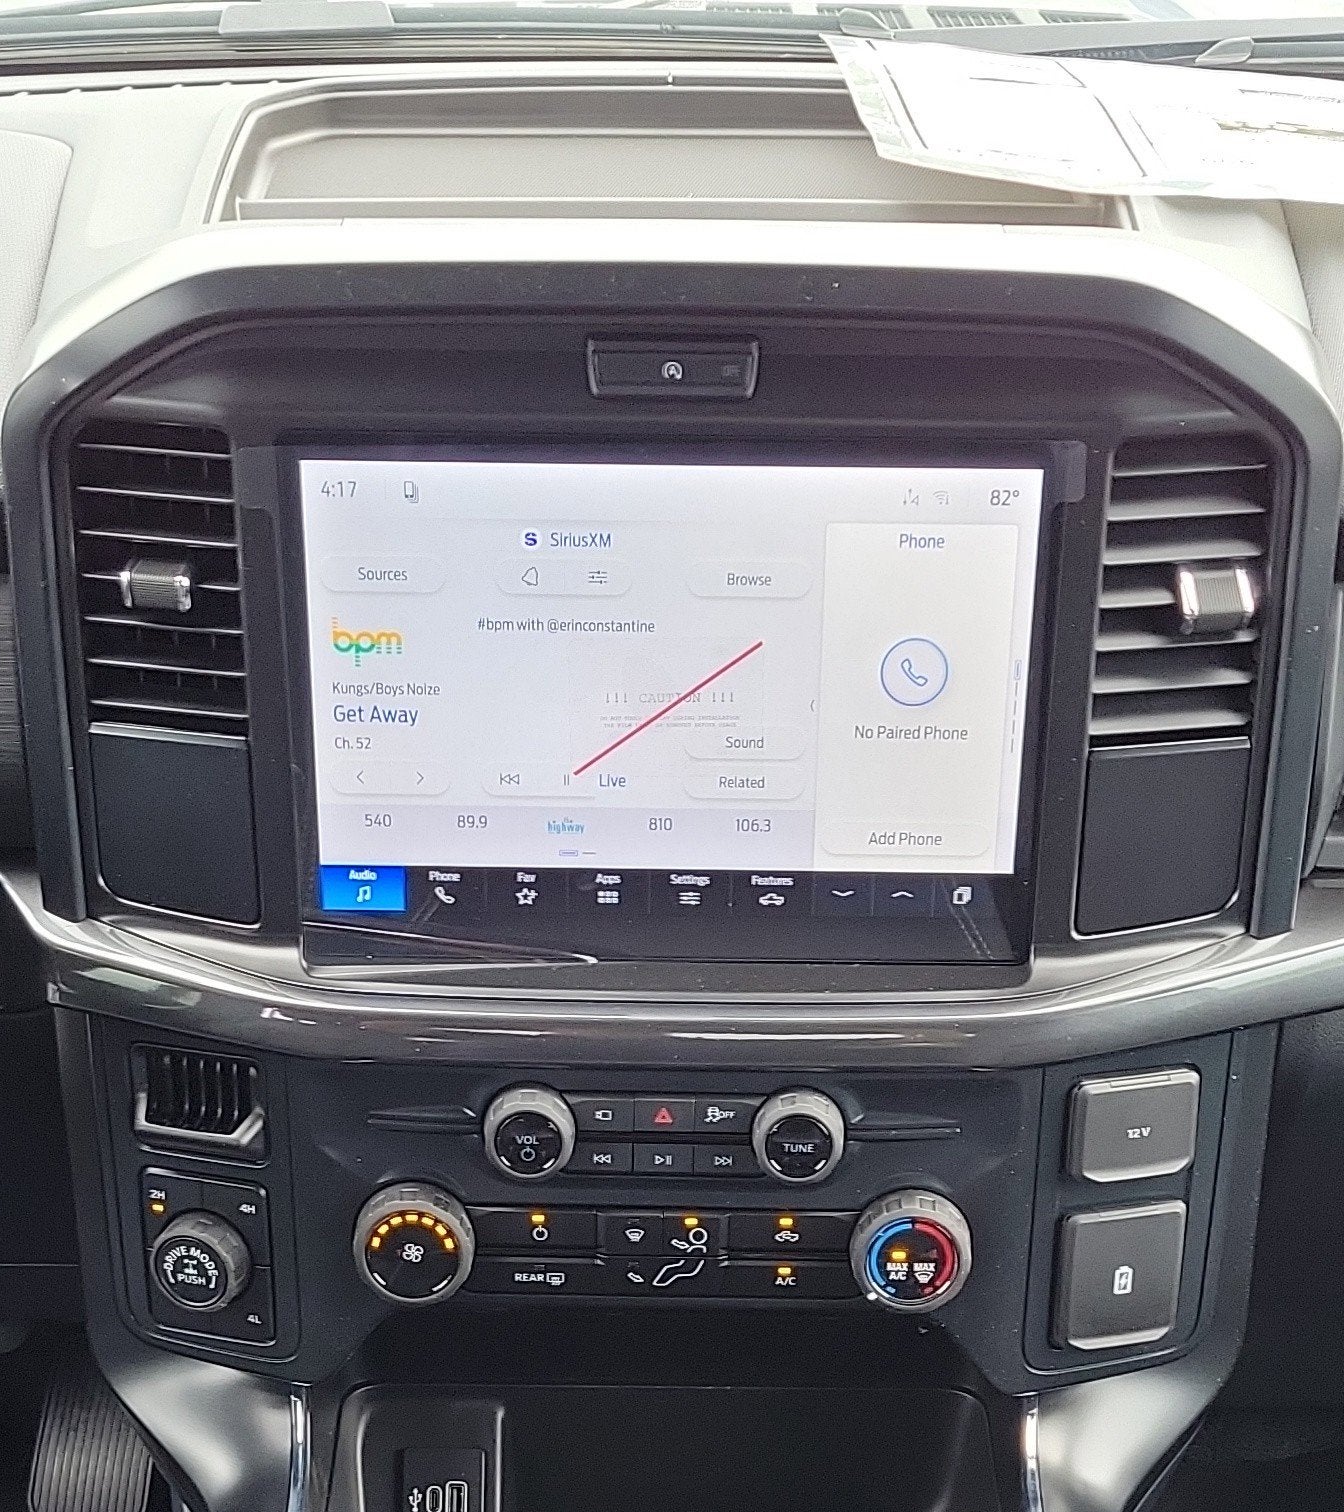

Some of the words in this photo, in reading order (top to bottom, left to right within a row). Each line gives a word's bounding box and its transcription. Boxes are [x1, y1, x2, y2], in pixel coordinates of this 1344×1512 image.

[321, 481, 357, 498] 4:17
[990, 489, 1020, 506] 82°
[550, 532, 612, 548] SiriusXM
[899, 533, 945, 549] Phone
[357, 567, 408, 582] Sources
[727, 573, 772, 587] Browse
[478, 618, 514, 633] #bpm
[516, 618, 544, 631] with
[547, 619, 655, 633] @erinconstantine
[332, 616, 403, 667] bpm
[332, 682, 404, 697] Kungs/Boys
[407, 683, 441, 696] Noize
[333, 705, 364, 723] Get
[370, 706, 418, 726] Away
[854, 726, 874, 740] No
[877, 726, 920, 740] Paired
[923, 726, 968, 741] Phone
[334, 737, 354, 750] Ch.
[356, 737, 372, 750] 52
[725, 736, 764, 750] Sound
[599, 774, 626, 788] Live
[718, 776, 765, 789] Related
[364, 814, 392, 828] 540
[457, 815, 487, 829] 89.9
[648, 818, 673, 831] 810
[735, 819, 772, 832] 106.3
[868, 832, 896, 846] Add
[899, 832, 942, 846] Phone
[349, 870, 377, 881] Audio
[428, 871, 461, 882] Phone
[516, 872, 537, 883] Fav
[595, 873, 622, 885] Apps
[669, 874, 711, 886] Settings
[750, 875, 794, 887] Features
[719, 1110, 736, 1119] OFF
[516, 1135, 540, 1145] VOL
[783, 1143, 815, 1153] TUNE
[149, 1189, 166, 1200] 2H
[239, 1203, 256, 1215] 4H
[163, 1246, 189, 1271] DRIVE
[189, 1246, 219, 1277] MODE
[886, 1262, 909, 1271] MAX
[913, 1262, 936, 1271] MAX
[176, 1273, 207, 1286] PUSH
[515, 1273, 544, 1283] REAR
[775, 1276, 797, 1287] A/C
[888, 1271, 907, 1280] A/C
[247, 1314, 262, 1324] 4L
